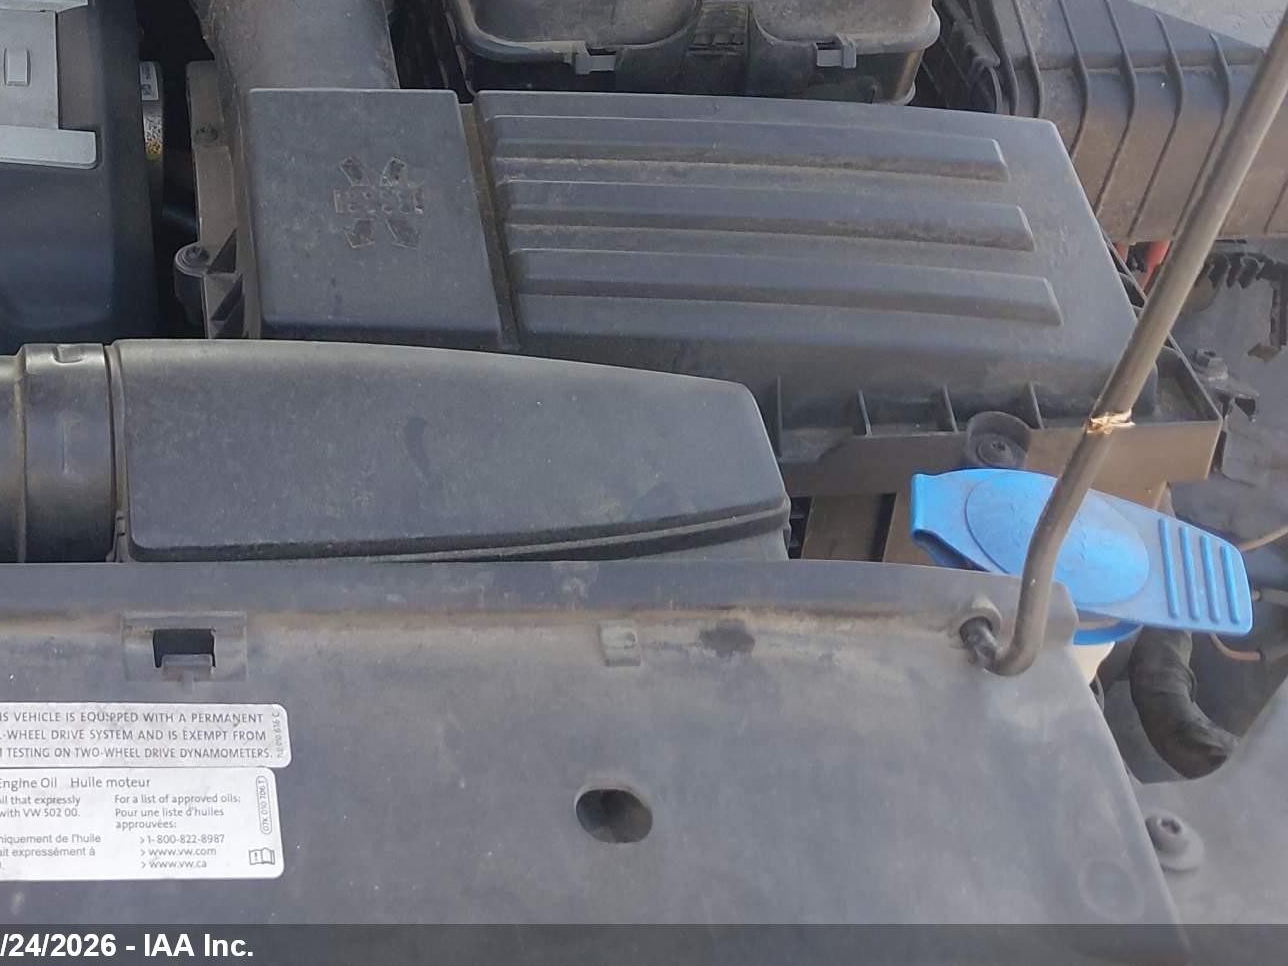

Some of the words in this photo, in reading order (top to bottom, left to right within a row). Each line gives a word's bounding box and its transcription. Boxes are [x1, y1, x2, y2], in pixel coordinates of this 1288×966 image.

[14, 711, 61, 722] VEHICLE
[66, 712, 76, 722] IS
[80, 712, 139, 723] EQUIPPED
[143, 712, 174, 723] WITH
[178, 712, 187, 723] A
[191, 712, 264, 723] PERMANENT
[51, 729, 85, 740] DRIVE
[89, 729, 133, 740] SYSTEM
[137, 730, 164, 740] AND
[168, 730, 178, 740] IS
[182, 730, 229, 740] EXEMPT
[233, 731, 267, 741] FROM
[7, 747, 50, 758] TESTING
[54, 747, 71, 758] ON
[75, 747, 141, 758] TWO-WHEEL
[144, 748, 177, 758] DRIVE
[40, 777, 58, 788] Oil
[70, 777, 102, 788] Huile
[105, 777, 151, 789] moteur
[10, 795, 32, 805] that
[33, 794, 81, 807] expressly
[114, 794, 131, 804] For
[132, 796, 139, 804] a
[140, 794, 156, 804] list
[158, 793, 170, 803] of
[171, 794, 219, 806] approved
[220, 793, 242, 803] oils:
[22, 807, 41, 818] VW
[43, 807, 62, 818] 502
[114, 807, 138, 818] Pour
[140, 809, 160, 818] une
[162, 807, 183, 818] liste
[185, 806, 225, 817] d'huiles
[55, 833, 69, 843] de
[71, 833, 102, 843] l'huile
[88, 846, 96, 856] à
